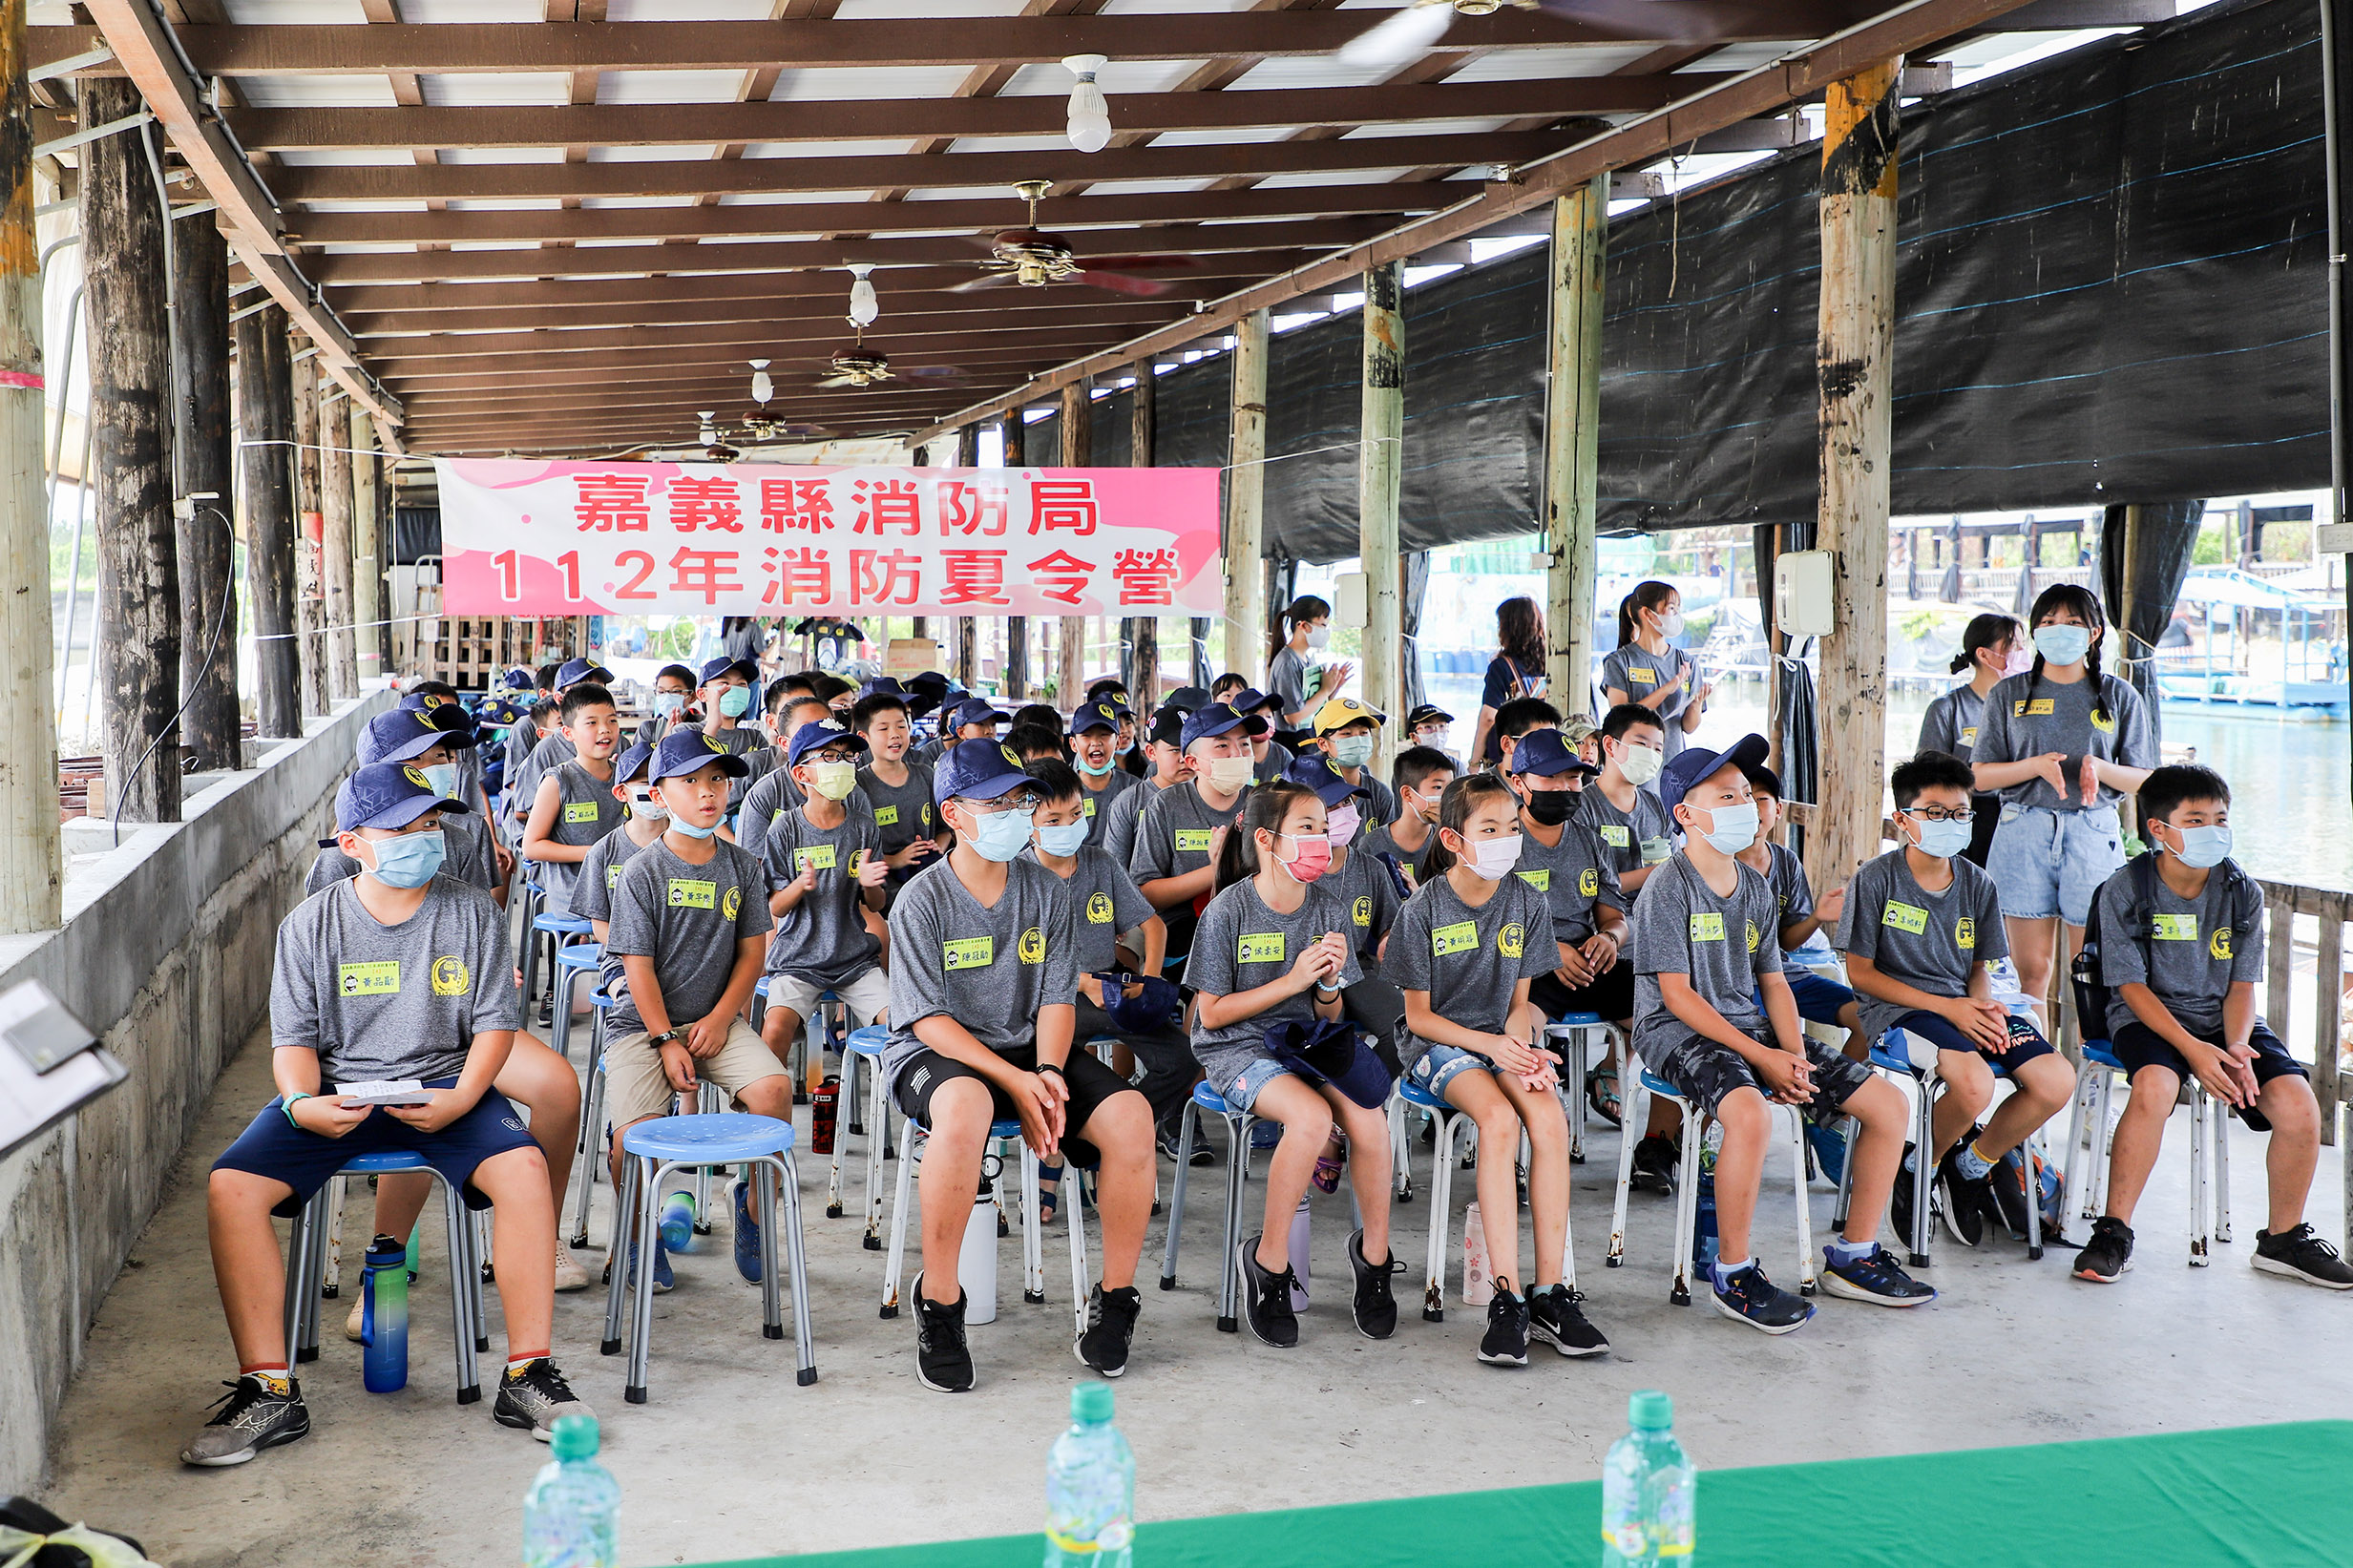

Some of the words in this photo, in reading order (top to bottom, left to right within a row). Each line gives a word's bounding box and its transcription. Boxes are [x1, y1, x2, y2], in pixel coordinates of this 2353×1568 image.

[573, 474, 1097, 536] 嘉義縣消防局
[494, 546, 1179, 606] 112年消防夏令營
